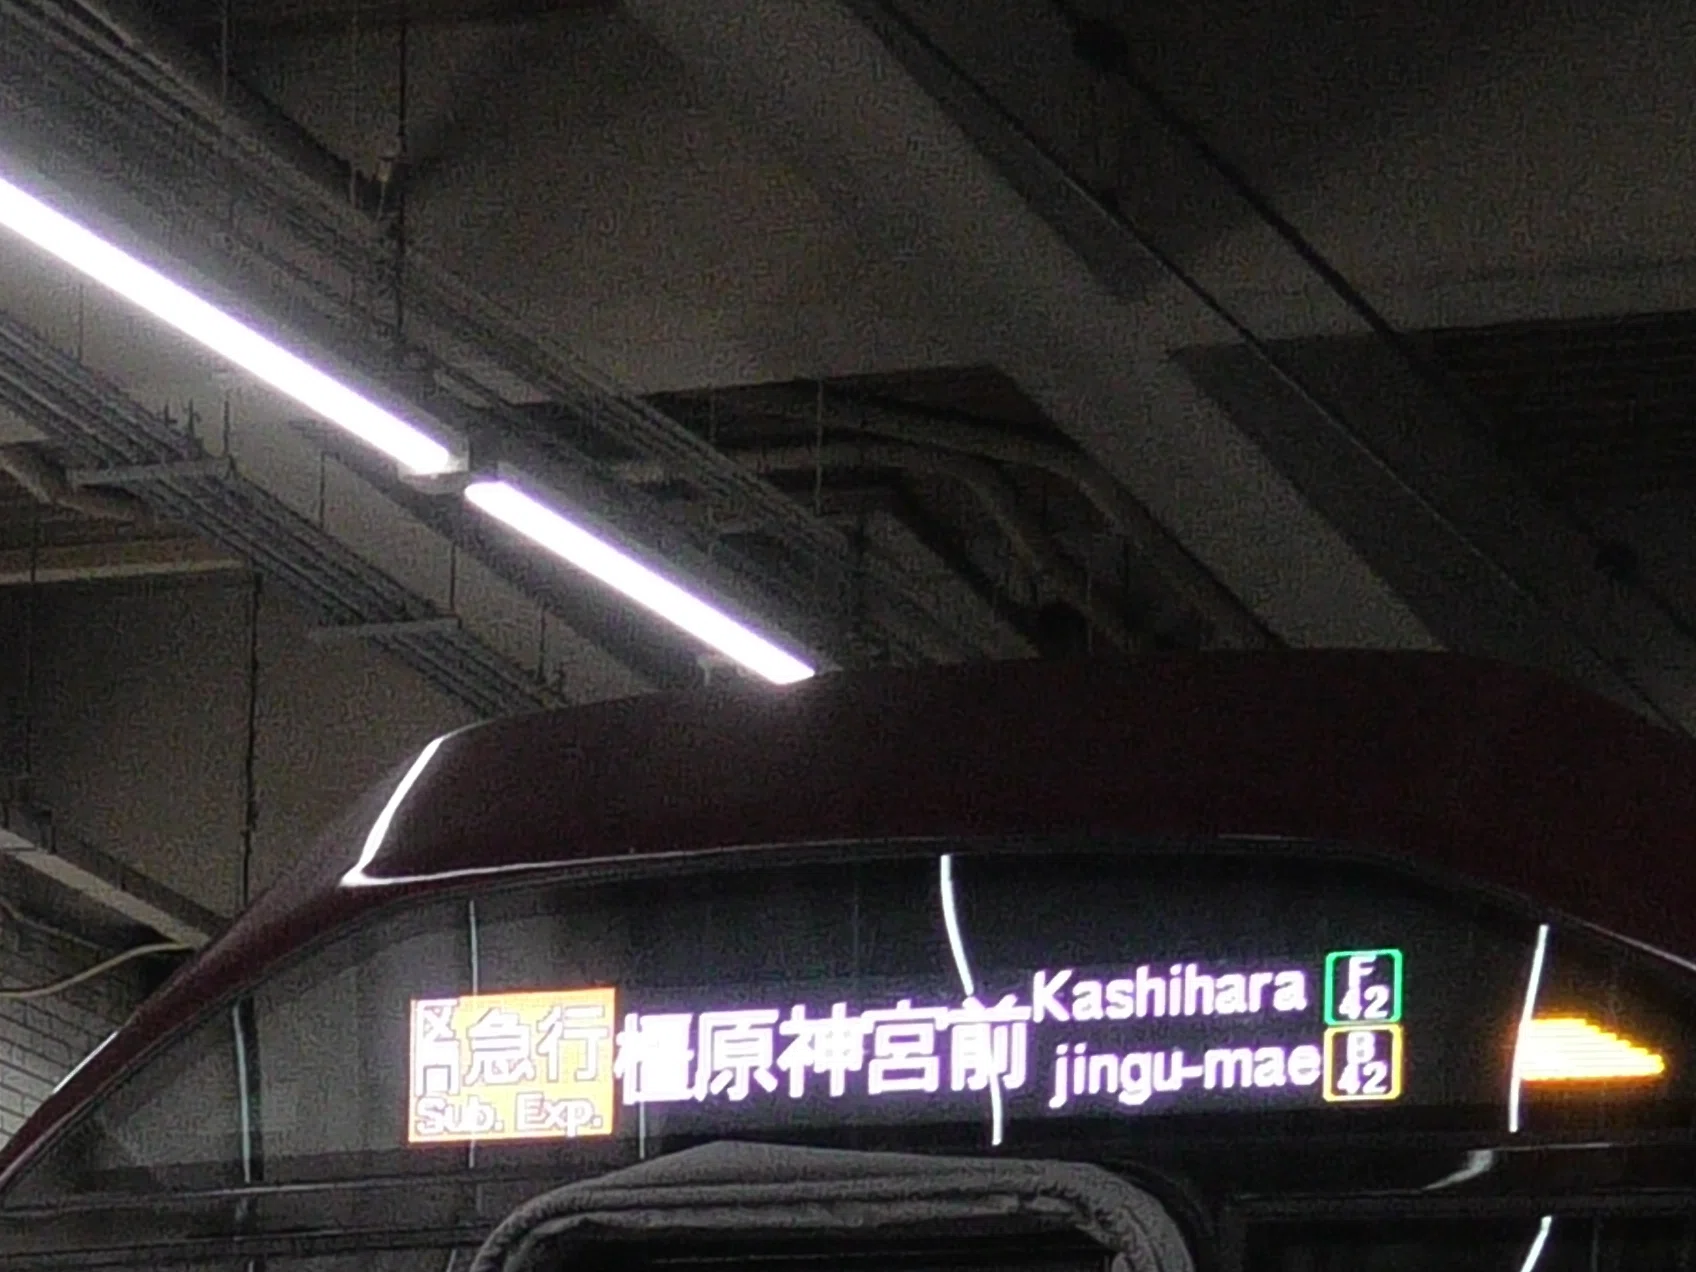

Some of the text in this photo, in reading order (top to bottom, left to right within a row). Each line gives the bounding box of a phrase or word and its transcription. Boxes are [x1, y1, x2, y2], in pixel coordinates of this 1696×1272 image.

[1347, 955, 1377, 988] F
[1033, 963, 1307, 1023] Kashihara
[1338, 985, 1390, 1020] 42
[1049, 1042, 1321, 1110] jingu-mae
[1337, 1061, 1389, 1095] 42
[416, 1091, 604, 1138] Sub. Exp.
